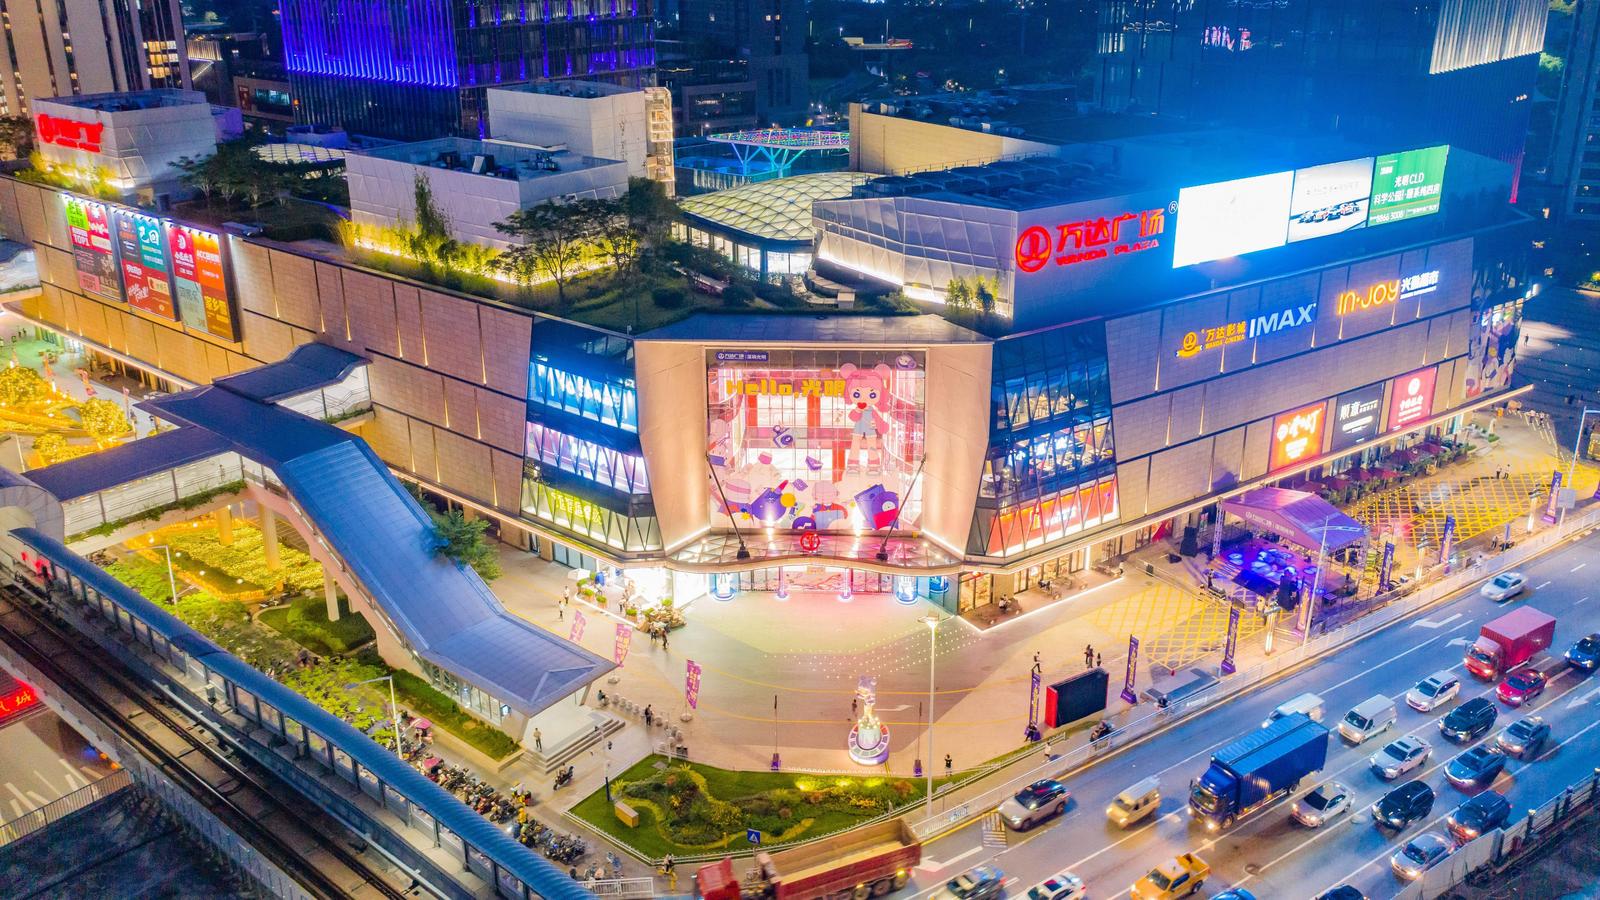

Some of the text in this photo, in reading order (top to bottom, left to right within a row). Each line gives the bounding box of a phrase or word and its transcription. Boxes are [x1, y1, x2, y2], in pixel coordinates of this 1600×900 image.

[1056, 208, 1165, 252] 万达广场
[1056, 239, 1160, 266] WANDA PLAZA
[1205, 320, 1246, 342] 万达影城
[1249, 303, 1315, 338] IMAX
